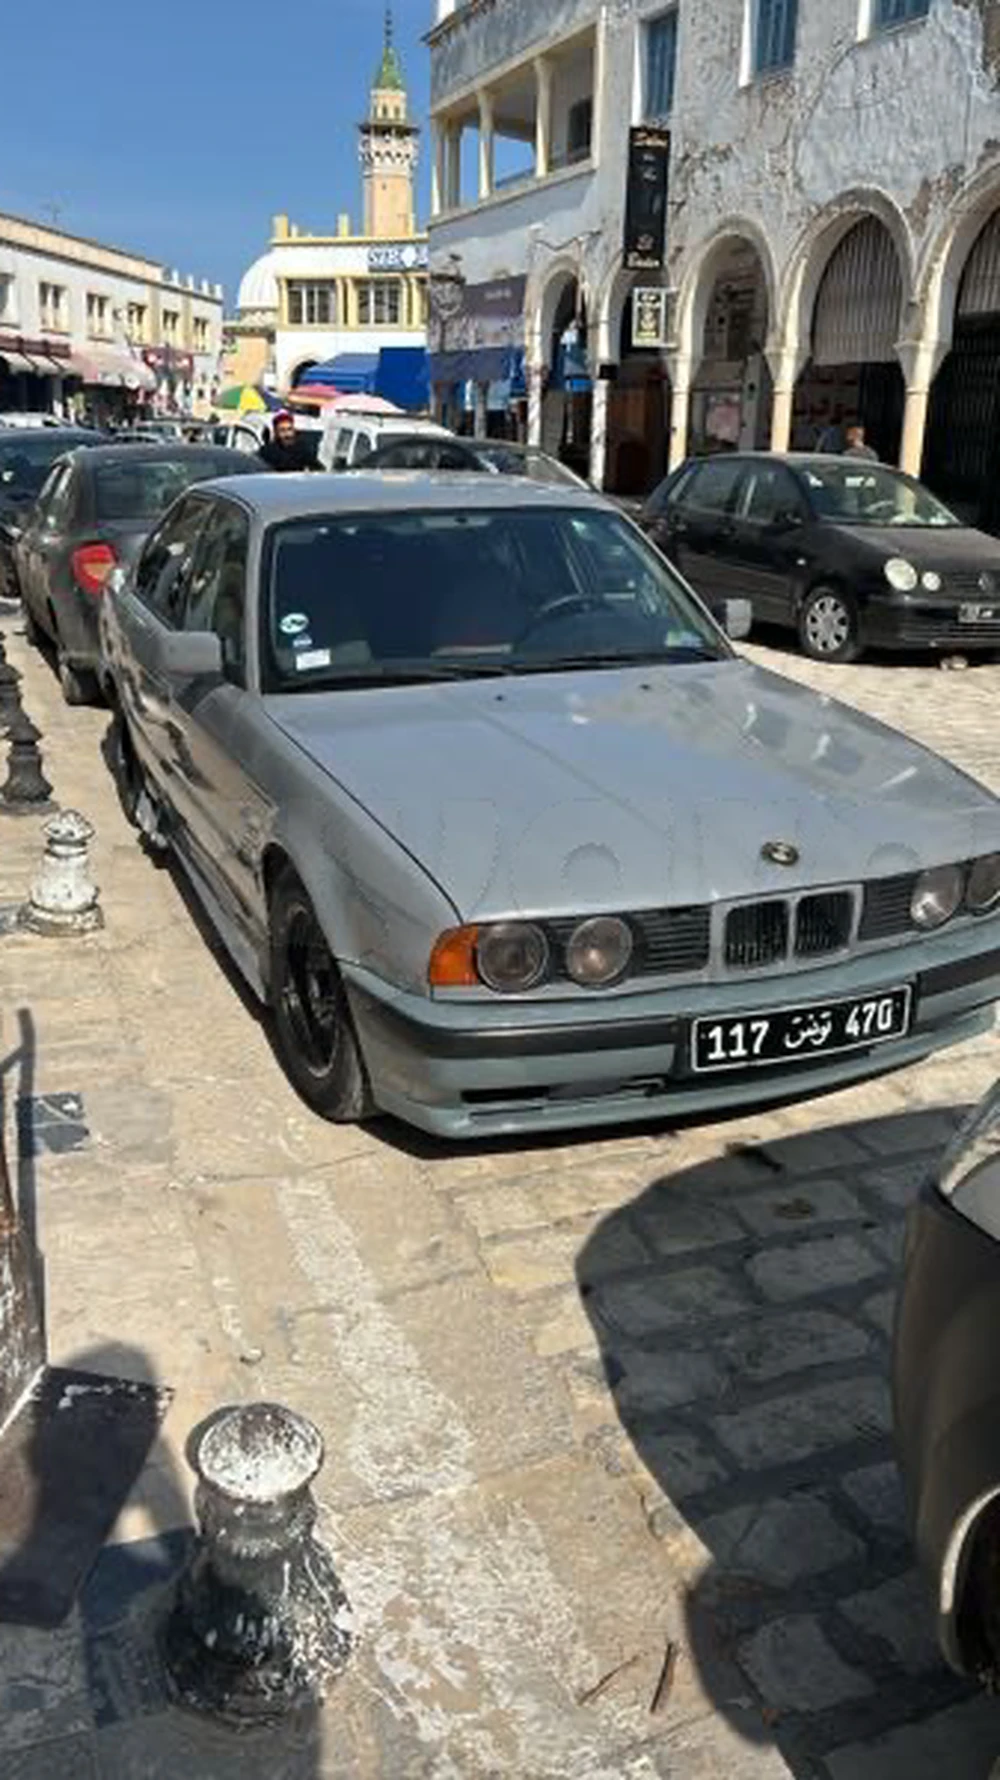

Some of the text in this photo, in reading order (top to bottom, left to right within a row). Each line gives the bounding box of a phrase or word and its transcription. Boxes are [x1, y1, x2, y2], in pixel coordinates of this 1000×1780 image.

[706, 998, 893, 1060] 117 تونس 470
